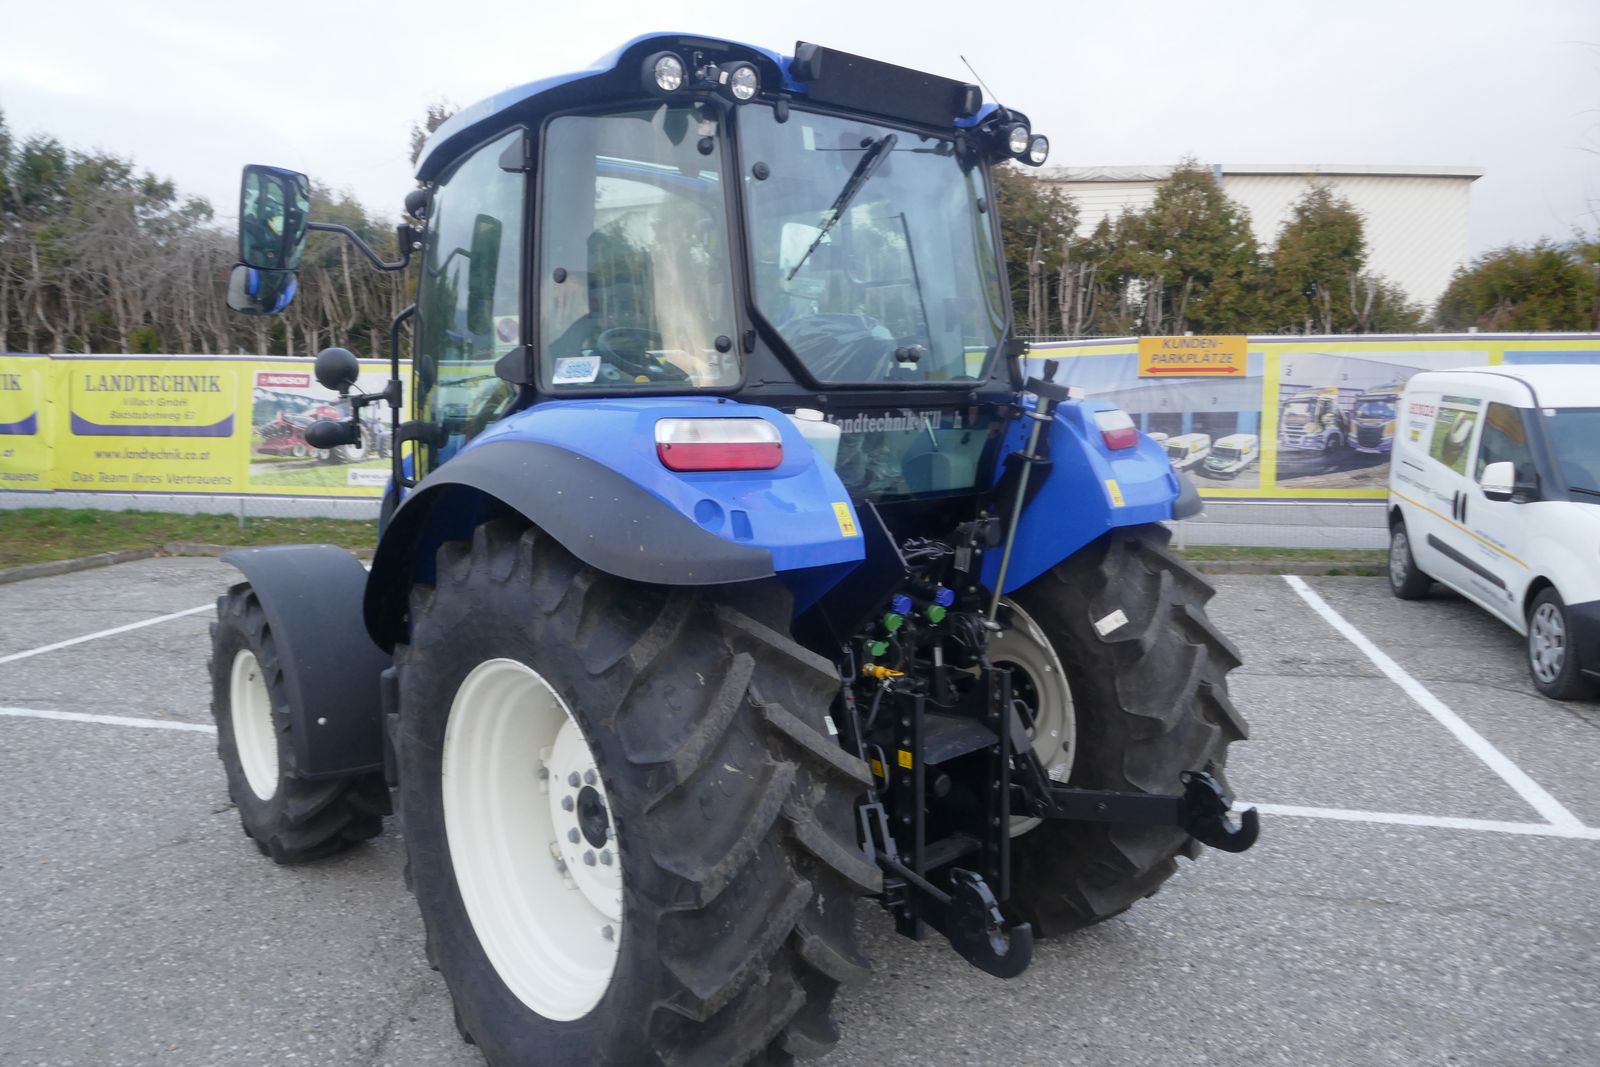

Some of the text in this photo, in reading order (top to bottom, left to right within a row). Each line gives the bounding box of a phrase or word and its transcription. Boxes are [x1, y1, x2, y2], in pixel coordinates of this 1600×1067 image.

[1162, 338, 1224, 349] KUNDEN-
[85, 374, 222, 393] LANDTECHNIK
[71, 472, 233, 485] Das Team Ihres Vertrauens
